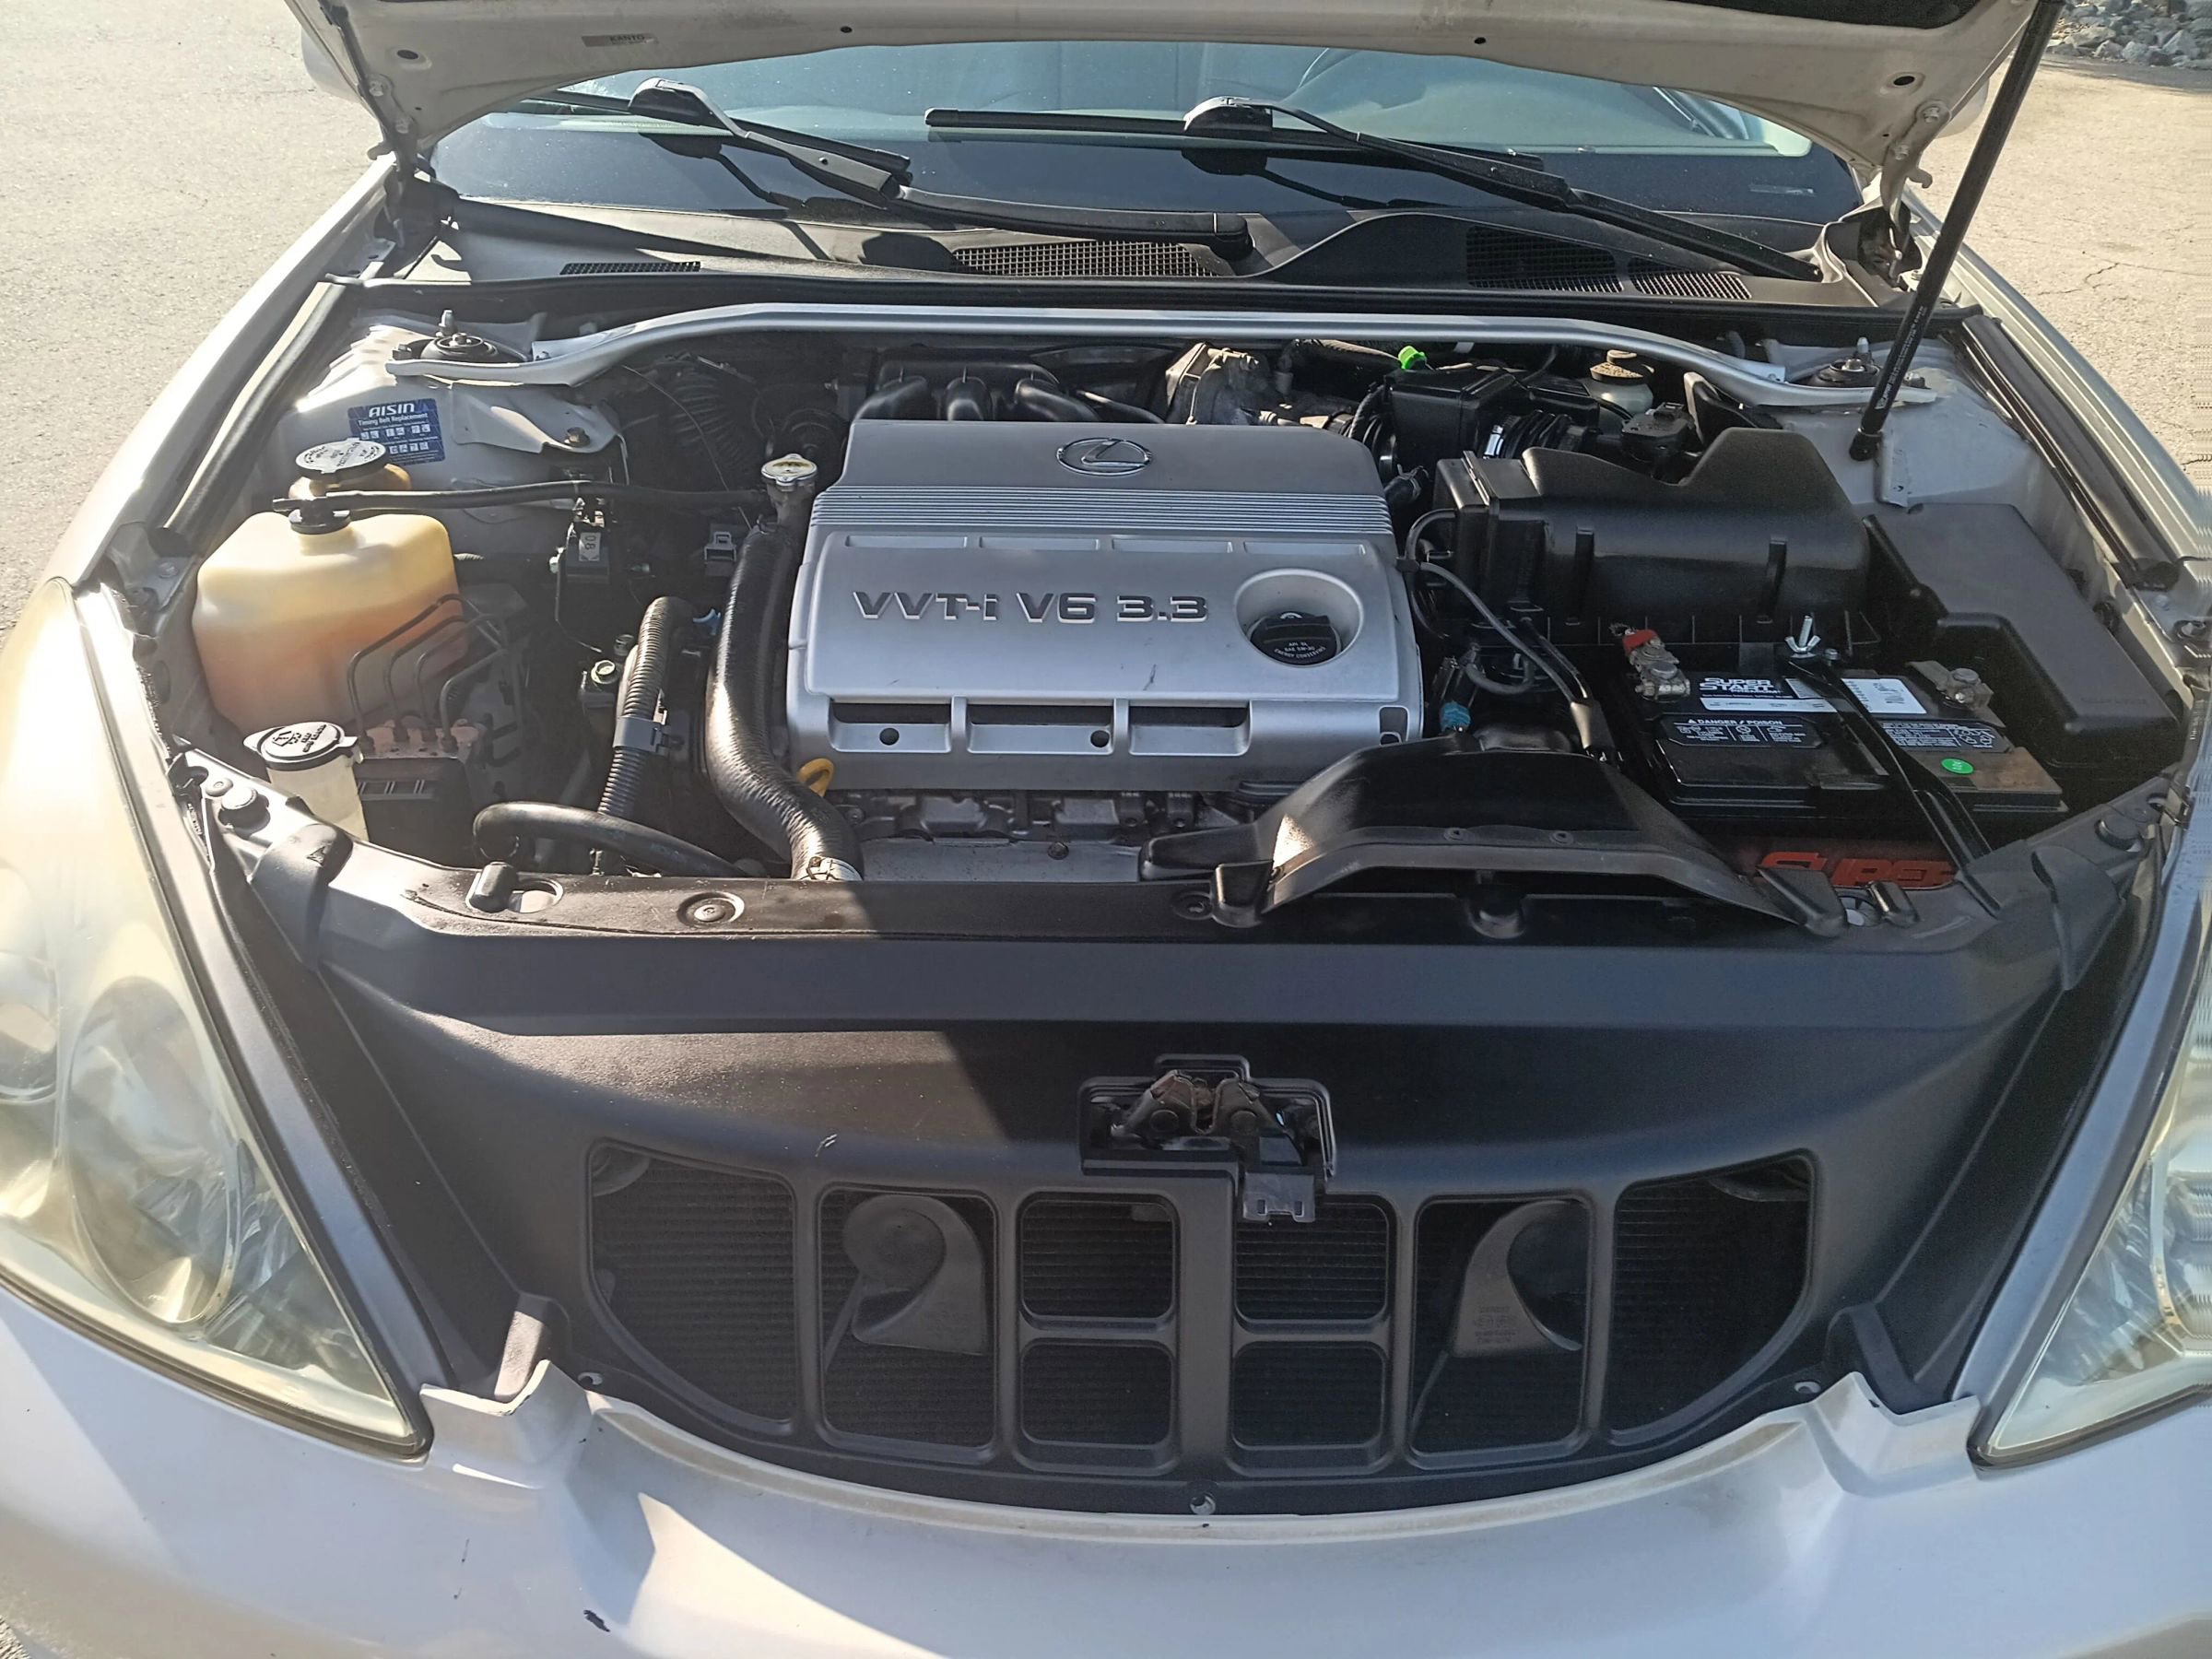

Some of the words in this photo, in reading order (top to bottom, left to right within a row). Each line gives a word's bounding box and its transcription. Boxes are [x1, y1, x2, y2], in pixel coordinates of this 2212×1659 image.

[369, 403, 415, 418] AISIN
[391, 413, 429, 423] Replacement
[853, 591, 1001, 622] VVT-i
[1015, 591, 1097, 624] V6
[1116, 594, 1208, 623] 3.3
[1700, 683, 1775, 691] START
